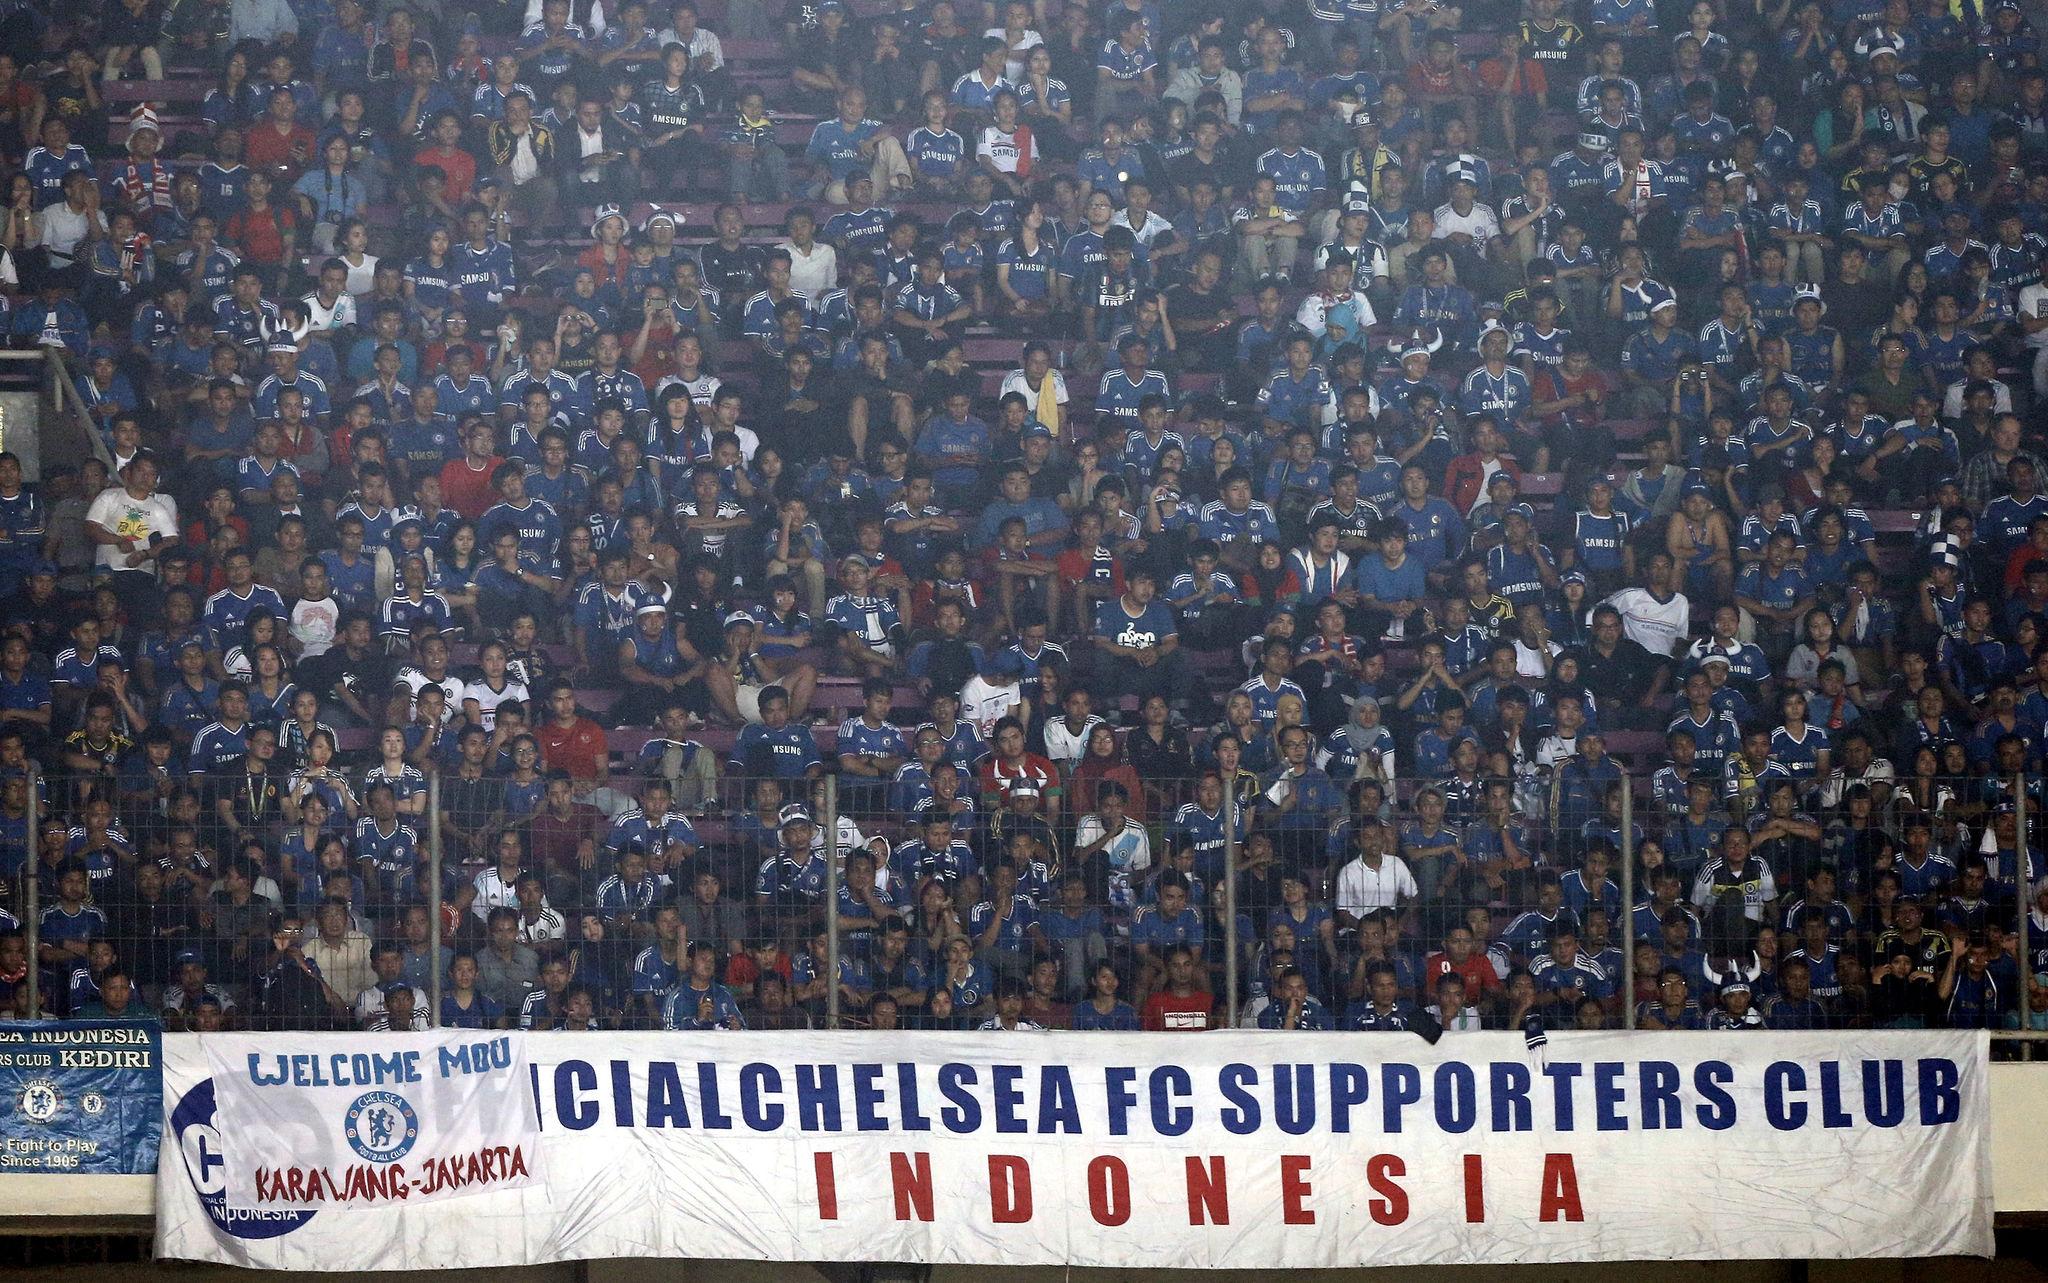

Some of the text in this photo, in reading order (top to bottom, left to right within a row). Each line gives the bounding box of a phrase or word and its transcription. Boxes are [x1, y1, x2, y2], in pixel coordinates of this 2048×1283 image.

[1532, 51, 1567, 60] AMSUNG
[652, 114, 688, 126] AMSUNG
[992, 149, 1021, 159] SAMSU
[43, 178, 61, 188] SAM
[845, 225, 885, 240] SAMSUNG
[417, 275, 449, 288] SAMSUNG
[460, 272, 490, 286] SAMSU
[1715, 354, 1733, 364] SAM
[1114, 406, 1138, 417] SAMS
[1139, 467, 1151, 477] SA
[1584, 538, 1615, 548] SAMSU
[1502, 582, 1542, 597] SAMSUNG
[1183, 610, 1201, 619] SAM
[31, 1029, 150, 1045] INDONESIA
[16, 1054, 51, 1066] CLUB
[59, 1050, 151, 1069] KEDIRI
[248, 1037, 511, 1086] WELCOME MOU
[358, 1092, 402, 1107] CHELSEA
[1104, 1064, 1194, 1137] FC
[1219, 1060, 1741, 1136] SUPPORTERS
[1764, 1059, 1960, 1131] CLUB
[7, 1139, 98, 1154] Fight to Play
[357, 1146, 407, 1161] FOOTBALL CLUB
[1, 1155, 79, 1167] Since 1905
[815, 1151, 1585, 1227] INDONESIA
